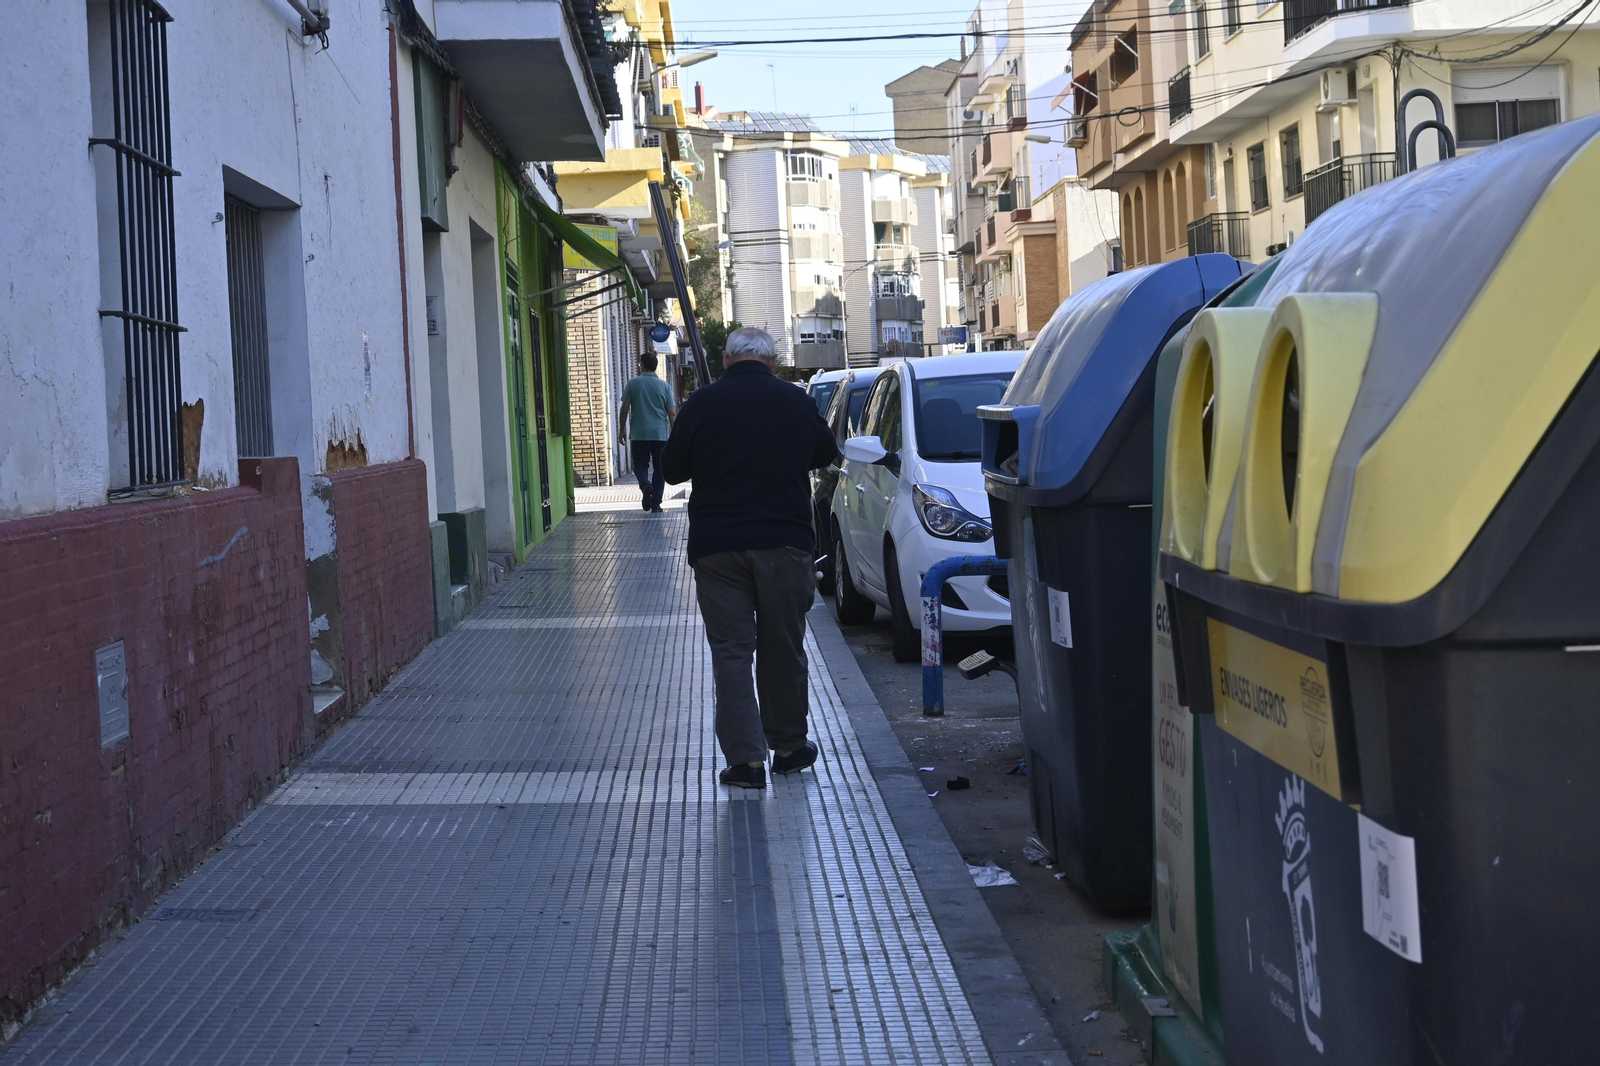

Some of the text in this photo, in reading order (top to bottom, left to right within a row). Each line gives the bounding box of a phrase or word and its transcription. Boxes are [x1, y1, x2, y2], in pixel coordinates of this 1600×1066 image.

[1220, 666, 1251, 710] ENVASES
[1251, 682, 1288, 728] LIGEROS
[1159, 717, 1187, 778] GESTO
